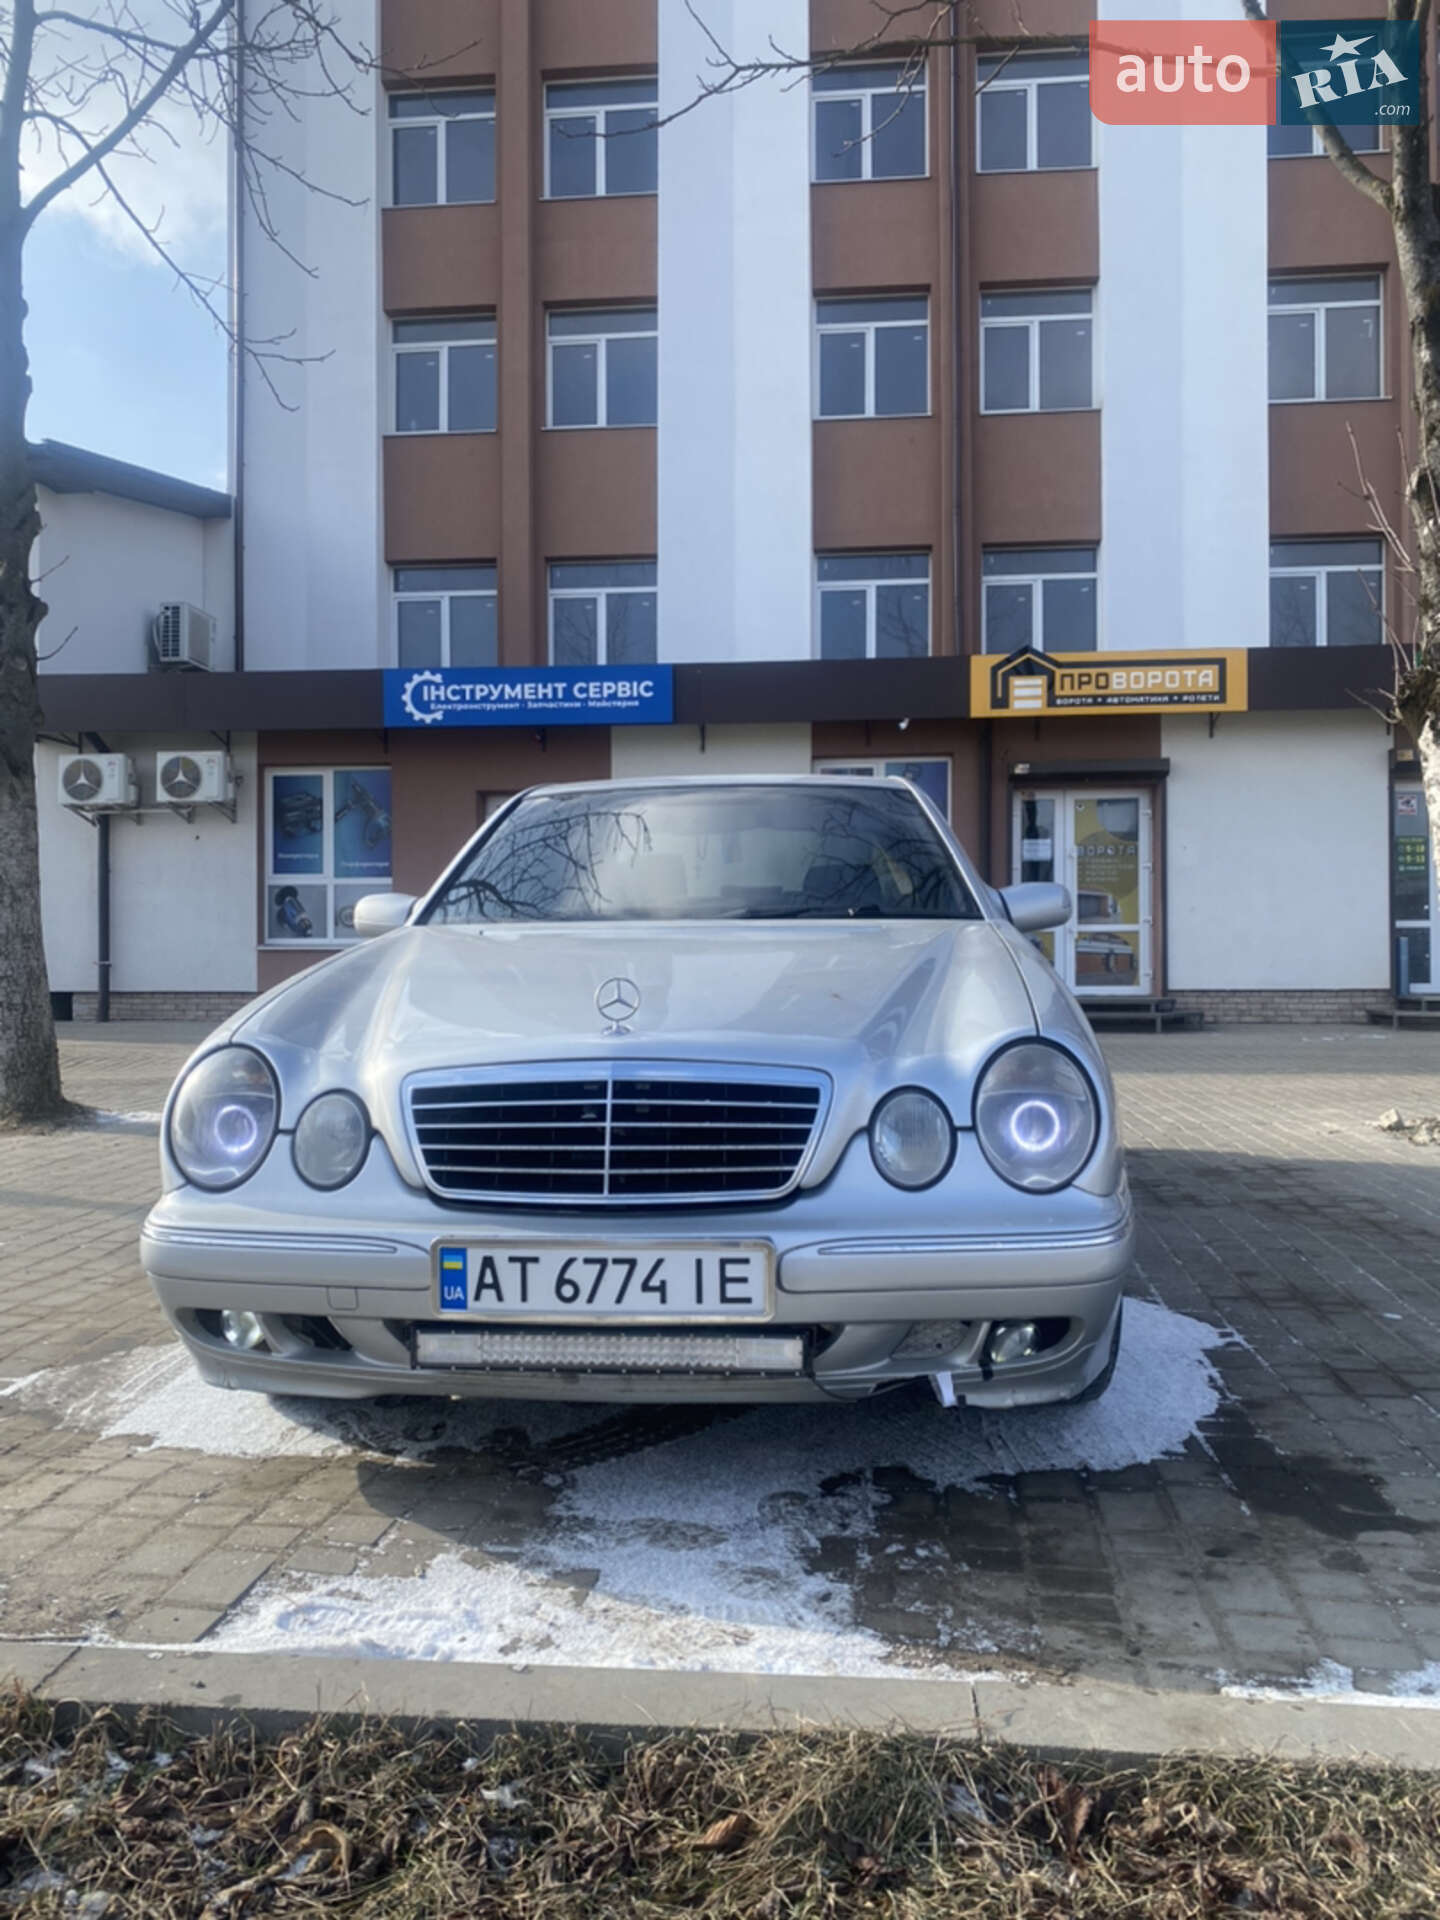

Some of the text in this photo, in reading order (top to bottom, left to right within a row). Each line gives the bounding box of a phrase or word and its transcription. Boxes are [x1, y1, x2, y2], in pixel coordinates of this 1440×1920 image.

[422, 680, 655, 701] ІНСТРУМЕНТ СЕРВІС
[1059, 670, 1214, 691] ПРОВОРОТА
[473, 1256, 753, 1305] AT 6774 IE
[443, 1286, 465, 1300] UA
